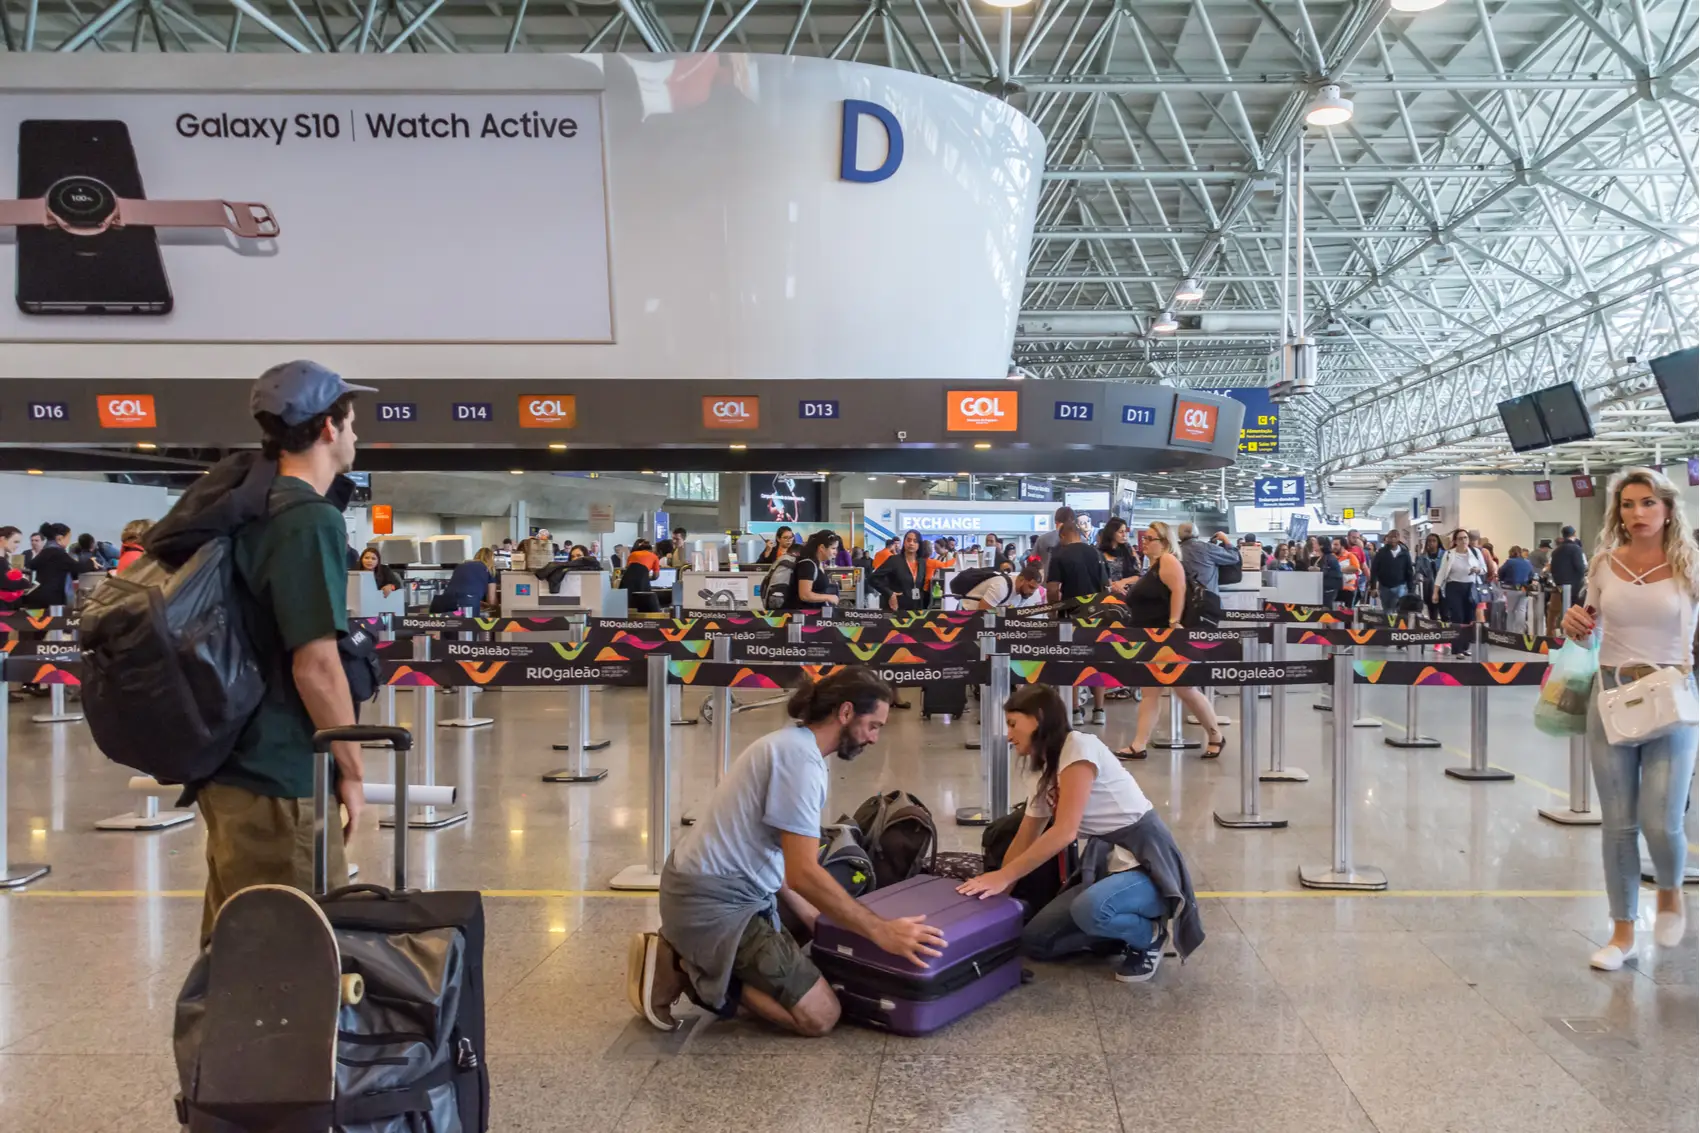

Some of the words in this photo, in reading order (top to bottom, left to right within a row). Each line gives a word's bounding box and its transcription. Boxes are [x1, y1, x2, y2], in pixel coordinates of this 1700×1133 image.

[176, 112, 288, 146] Galaxy
[294, 113, 340, 138] S10
[365, 112, 470, 139] Watch
[480, 110, 578, 139] Active
[841, 99, 904, 183] D
[33, 404, 64, 419] D16
[108, 400, 147, 417] GOL
[382, 405, 412, 419] D15
[458, 405, 488, 419] D14
[529, 400, 567, 417] GOL
[712, 401, 750, 418] GOL
[805, 403, 834, 417] D13
[960, 397, 1005, 417] GOL
[1060, 404, 1088, 419] D12
[1126, 408, 1150, 423] D11
[1184, 408, 1209, 429] GOL
[903, 517, 981, 530] EXCHANGE
[403, 619, 446, 629] RIOgaleão
[600, 619, 644, 629] RIOgaleão
[1005, 620, 1048, 629] RIOgaleão
[1188, 631, 1240, 642] RIOgaleão
[1391, 631, 1442, 643] RIOgaleão
[447, 644, 509, 658] RIOgaleão
[747, 644, 807, 658] RIOgaleão
[1010, 644, 1071, 657] RIOgaleão
[525, 666, 601, 682] RIOgaleão
[1212, 666, 1286, 682] RIOgaleão
